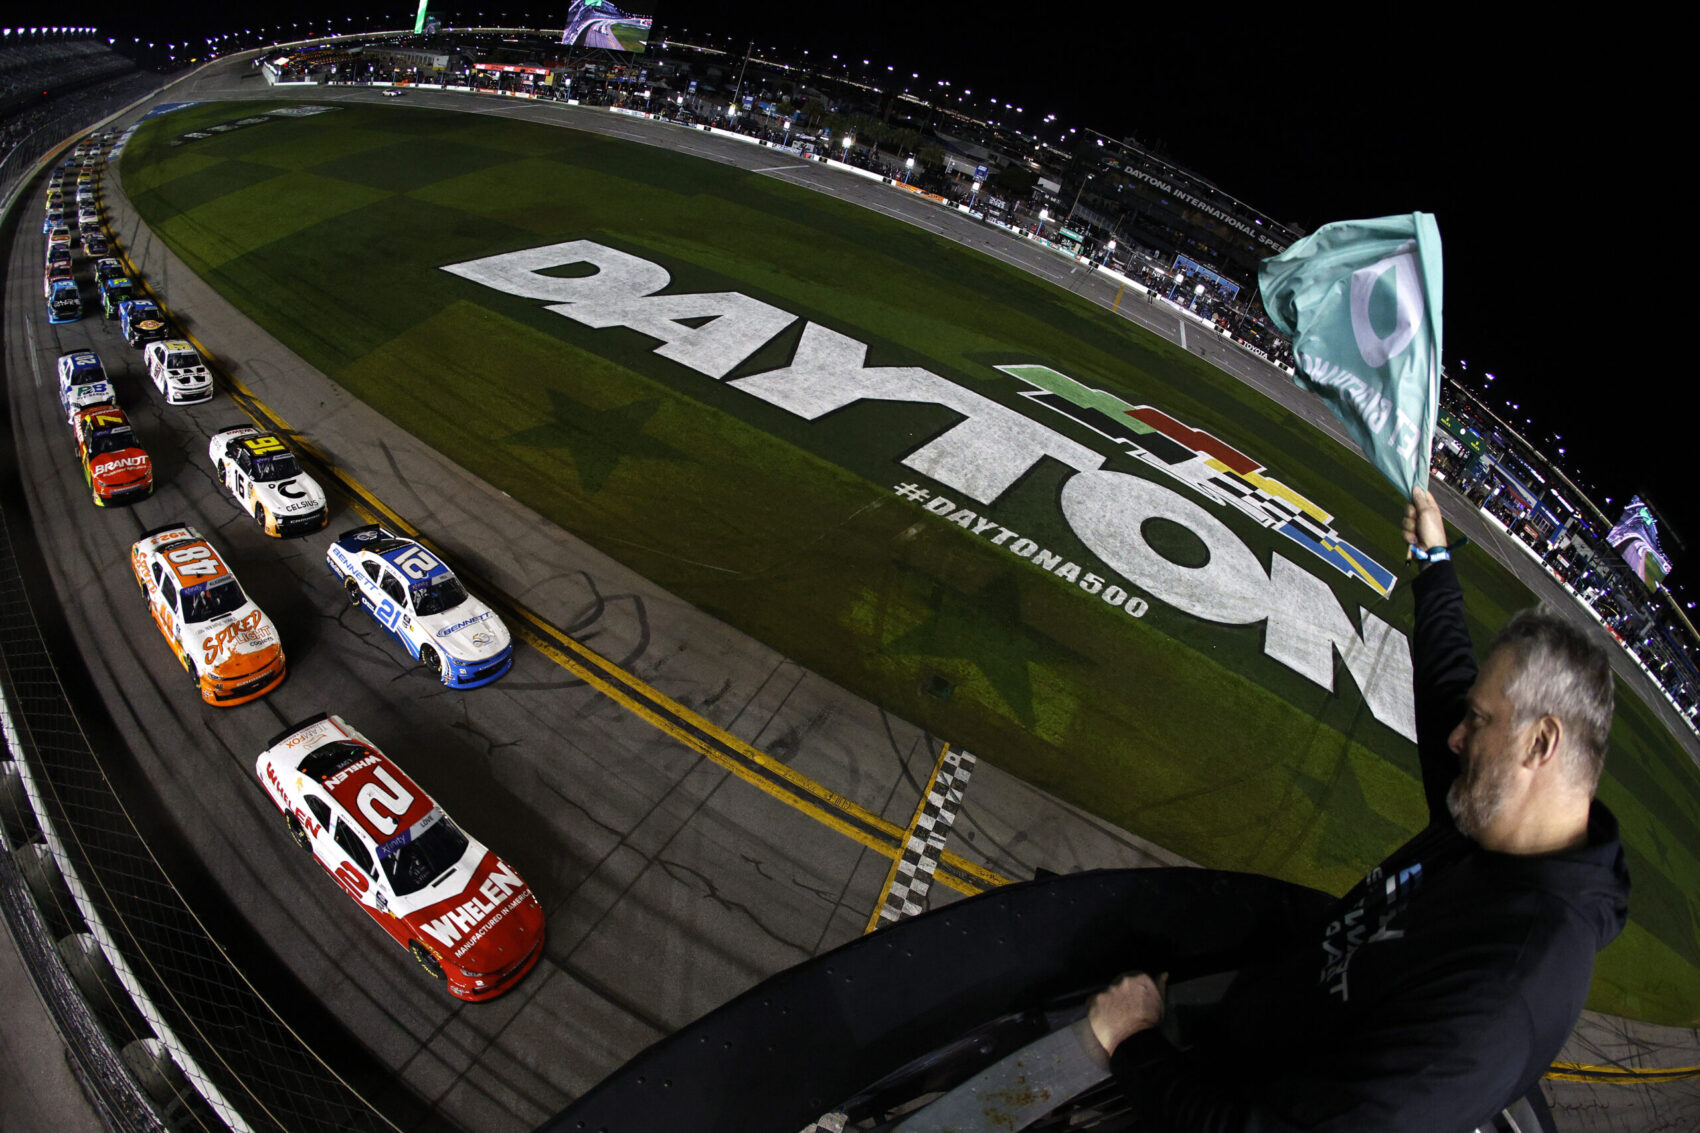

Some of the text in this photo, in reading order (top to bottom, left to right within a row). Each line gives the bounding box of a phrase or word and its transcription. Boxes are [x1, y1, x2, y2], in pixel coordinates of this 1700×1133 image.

[1124, 165, 1287, 254] DAYTONA INTERNATIONAL SPEE
[1243, 340, 1268, 360] TOYOTA
[95, 415, 122, 426] 7
[244, 436, 287, 455] 16
[93, 455, 149, 477] BRANDT
[285, 500, 319, 512] CELSIUS
[169, 546, 220, 576] 48
[393, 547, 439, 580] 21
[893, 481, 1149, 618] #DAYTONA500
[332, 548, 378, 591] BENNETT
[376, 598, 402, 630] 21
[443, 611, 491, 635] BENNETT
[203, 610, 262, 665] SPIKED
[235, 625, 271, 645] LIGHT
[324, 755, 382, 791] WHELEN
[266, 761, 322, 839] WHELEN
[357, 765, 414, 836] 2
[420, 814, 434, 828] LOVE
[382, 835, 406, 853] xfinity
[335, 860, 370, 899] 2
[419, 861, 524, 948] WHELEN
[454, 889, 532, 958] MANUFACTURED IN AMERICA
